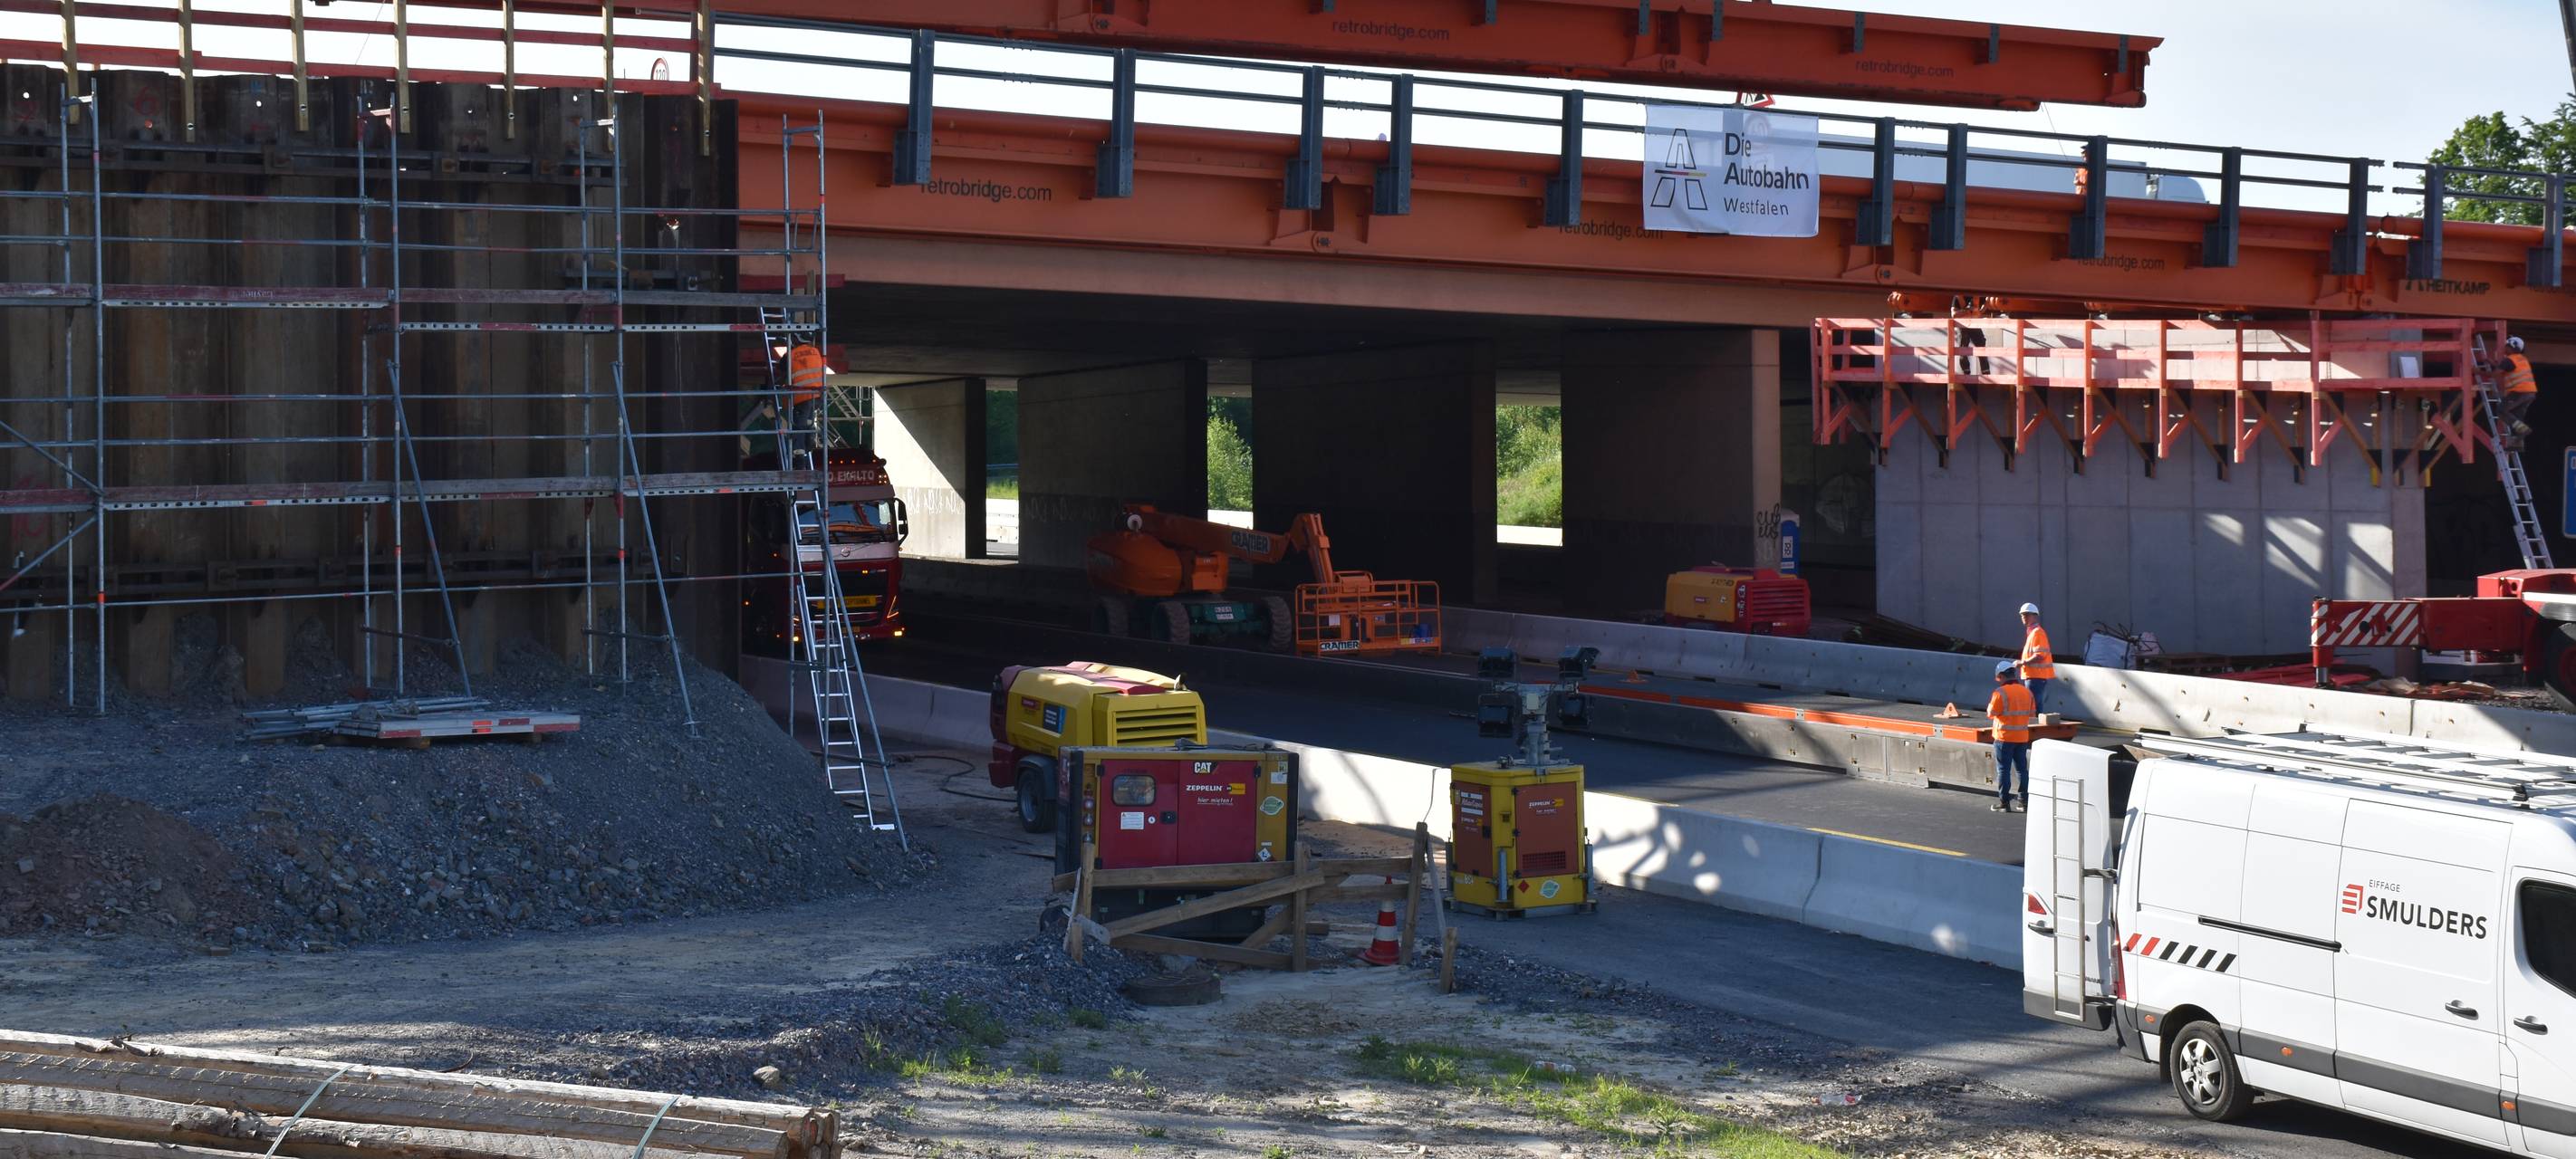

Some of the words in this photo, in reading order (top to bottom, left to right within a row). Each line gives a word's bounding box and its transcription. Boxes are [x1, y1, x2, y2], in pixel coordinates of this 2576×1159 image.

[1332, 19, 1450, 41] retrobridge.com
[1855, 59, 1955, 79] retrobridge.com
[1725, 132, 1752, 158] Die
[1724, 162, 1809, 189] Autobahn
[921, 177, 1053, 203] retrobridge.com
[1724, 197, 1789, 216] Westfalen
[2426, 279, 2491, 295] HEITKAMP
[1320, 640, 1360, 651] CRAMER
[1194, 761, 1213, 774] CAT
[2369, 879, 2400, 893] EIFFAGE
[2366, 896, 2487, 939] SMULDERS
